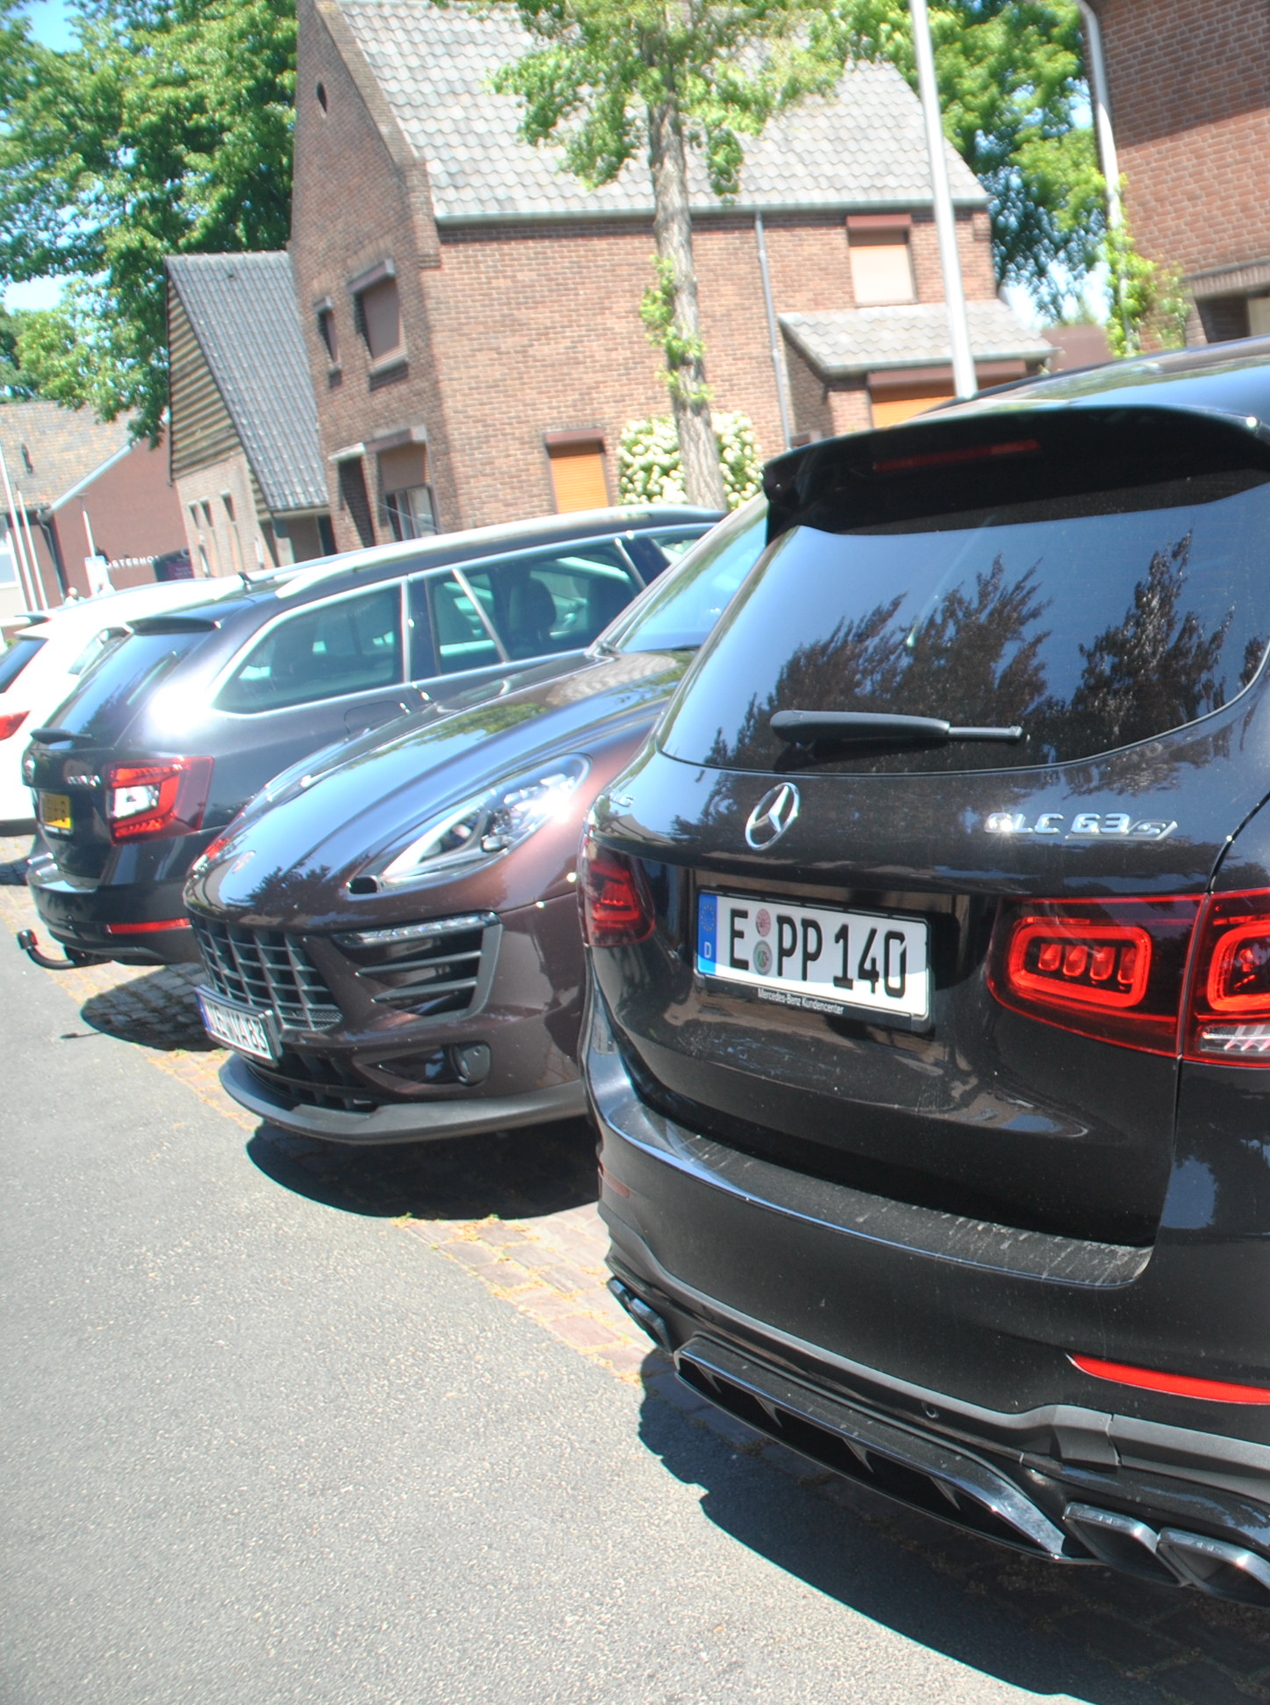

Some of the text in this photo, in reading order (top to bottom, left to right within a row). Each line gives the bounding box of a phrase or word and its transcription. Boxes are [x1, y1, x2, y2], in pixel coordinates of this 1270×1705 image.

[984, 812, 1064, 836] GLC
[1070, 812, 1131, 835] 63
[704, 941, 712, 959] D
[729, 908, 907, 998] E PP 140
[757, 987, 845, 1015] Mercedes-Benz Kundencenter
